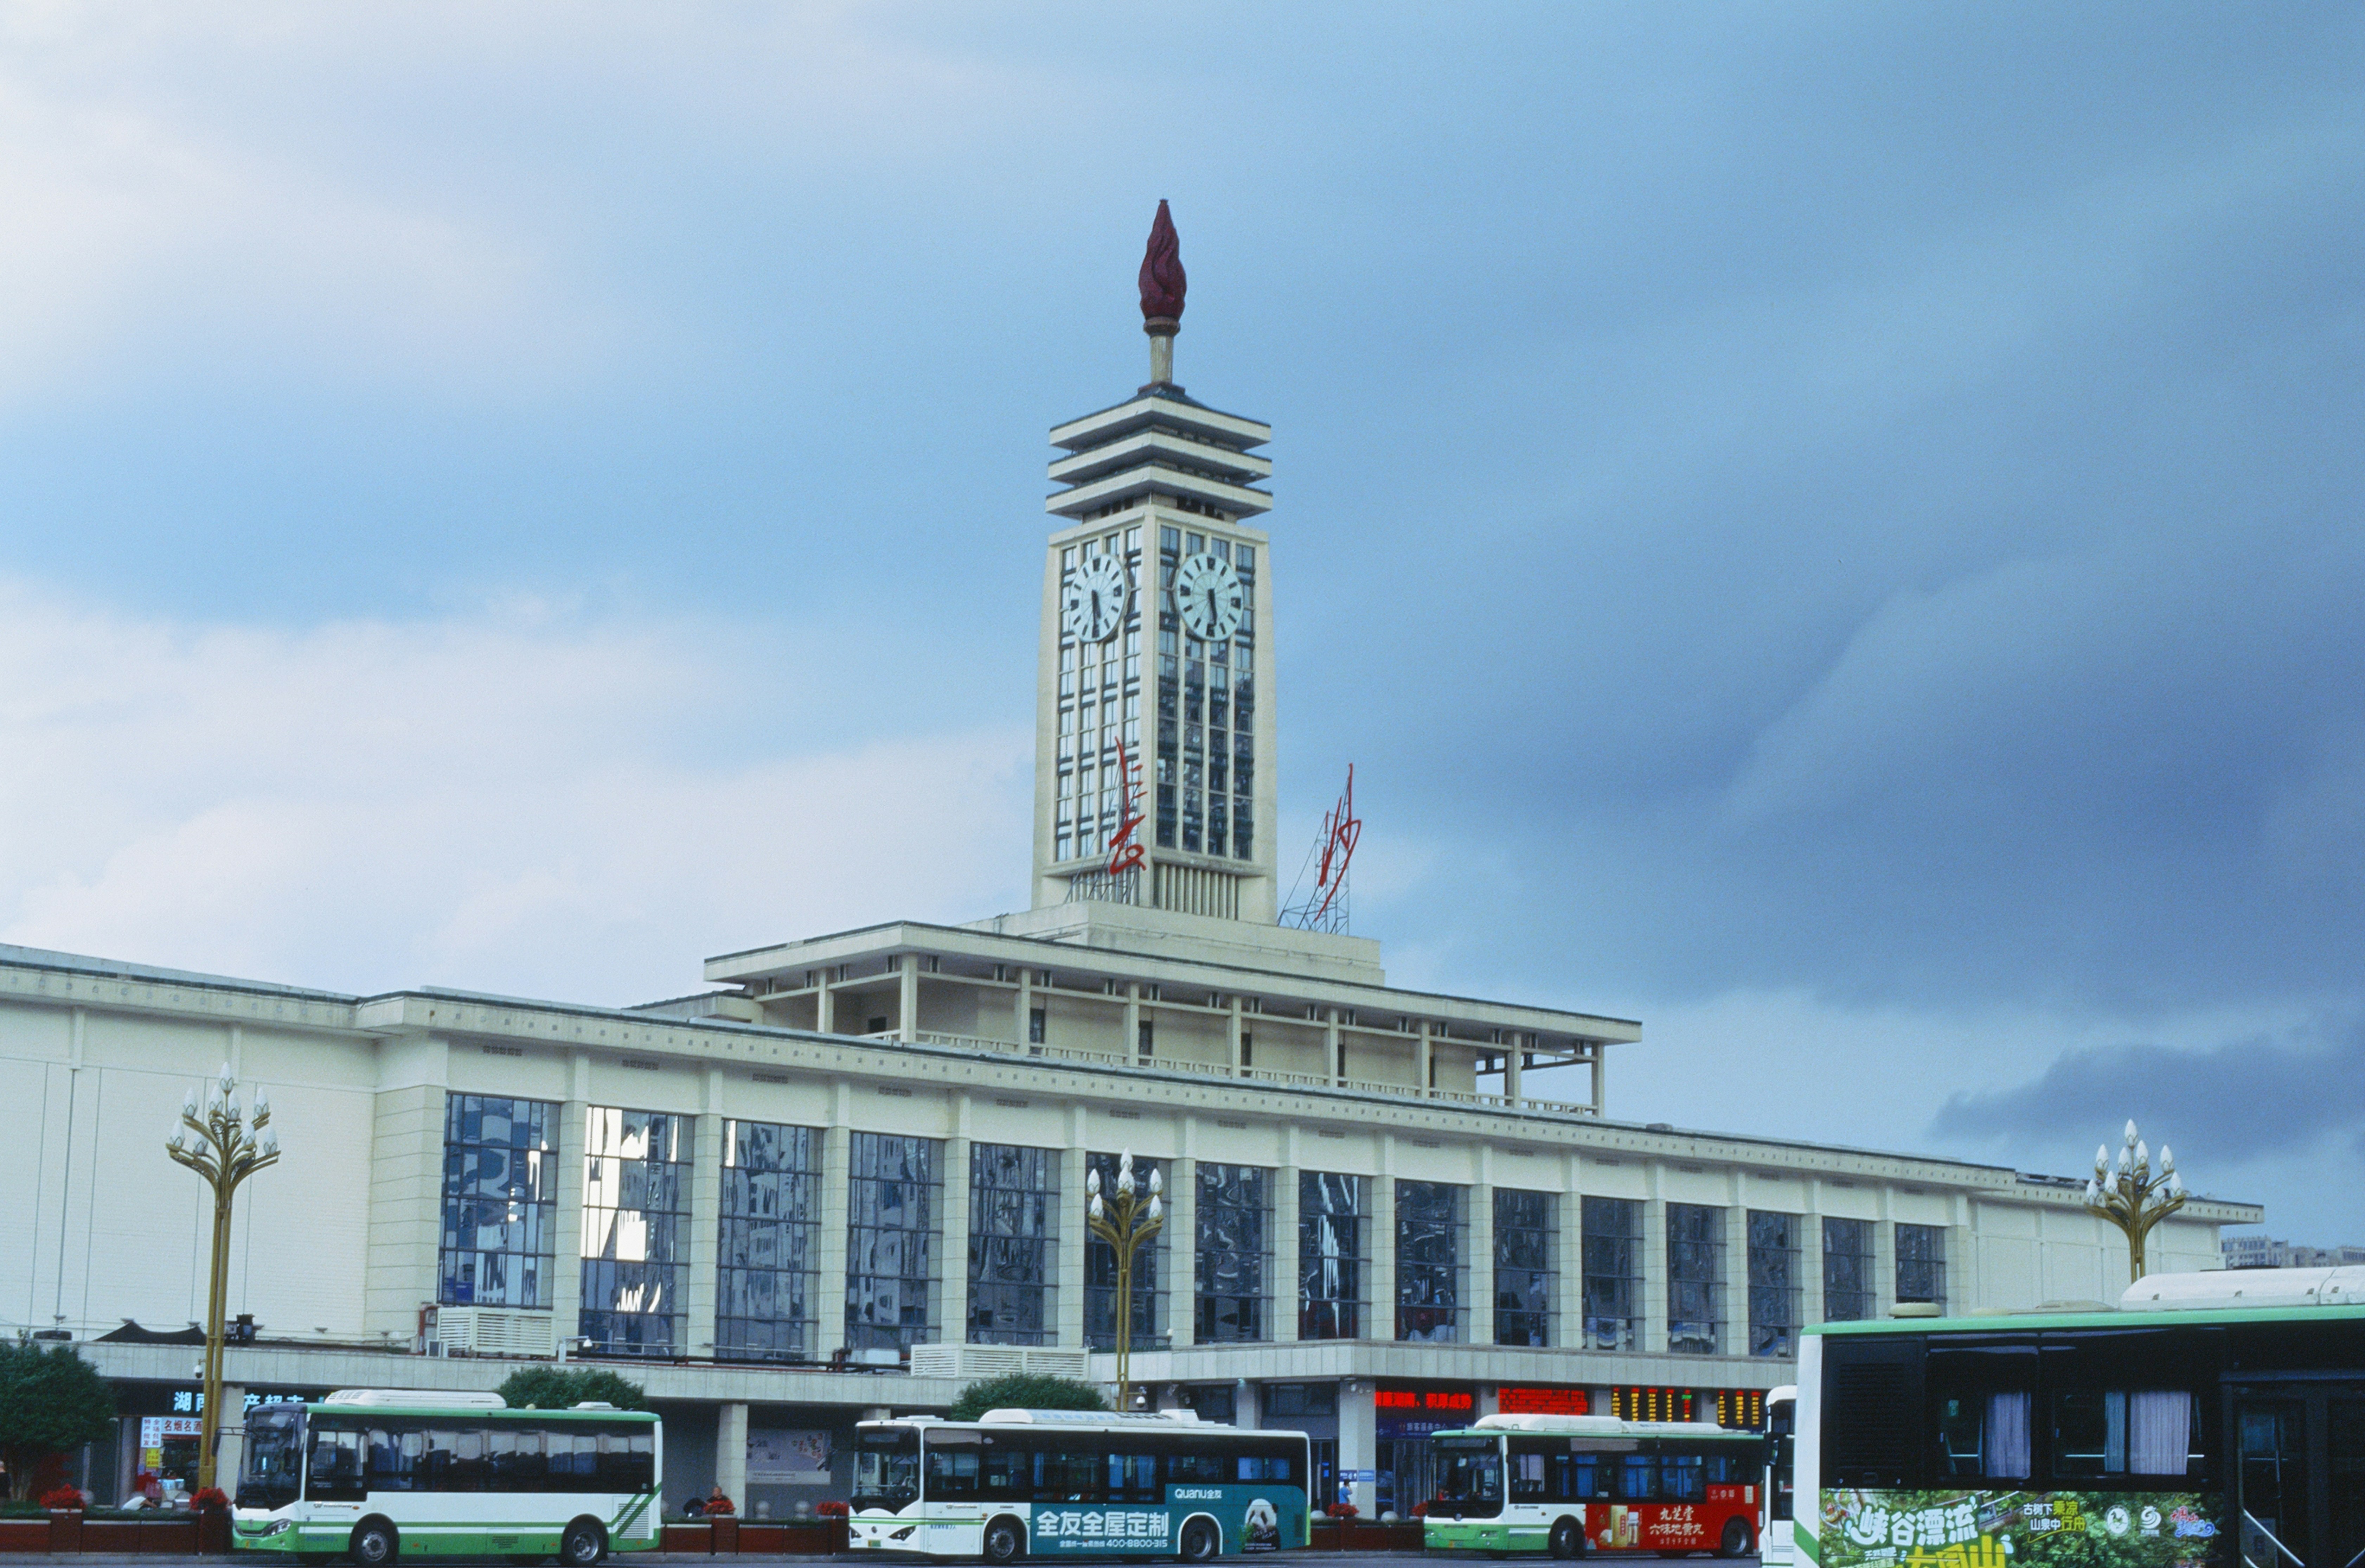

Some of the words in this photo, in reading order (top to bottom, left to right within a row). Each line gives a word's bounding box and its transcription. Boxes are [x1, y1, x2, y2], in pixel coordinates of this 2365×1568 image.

[2023, 1500, 2078, 1515] 古树下乘凉
[1037, 1511, 1169, 1537] 全友全屋定制
[1649, 1522, 1704, 1536] 六味地黄丸
[1850, 1503, 1979, 1546] 峡谷漂流
[1106, 1539, 1168, 1548] 400-8800-315
